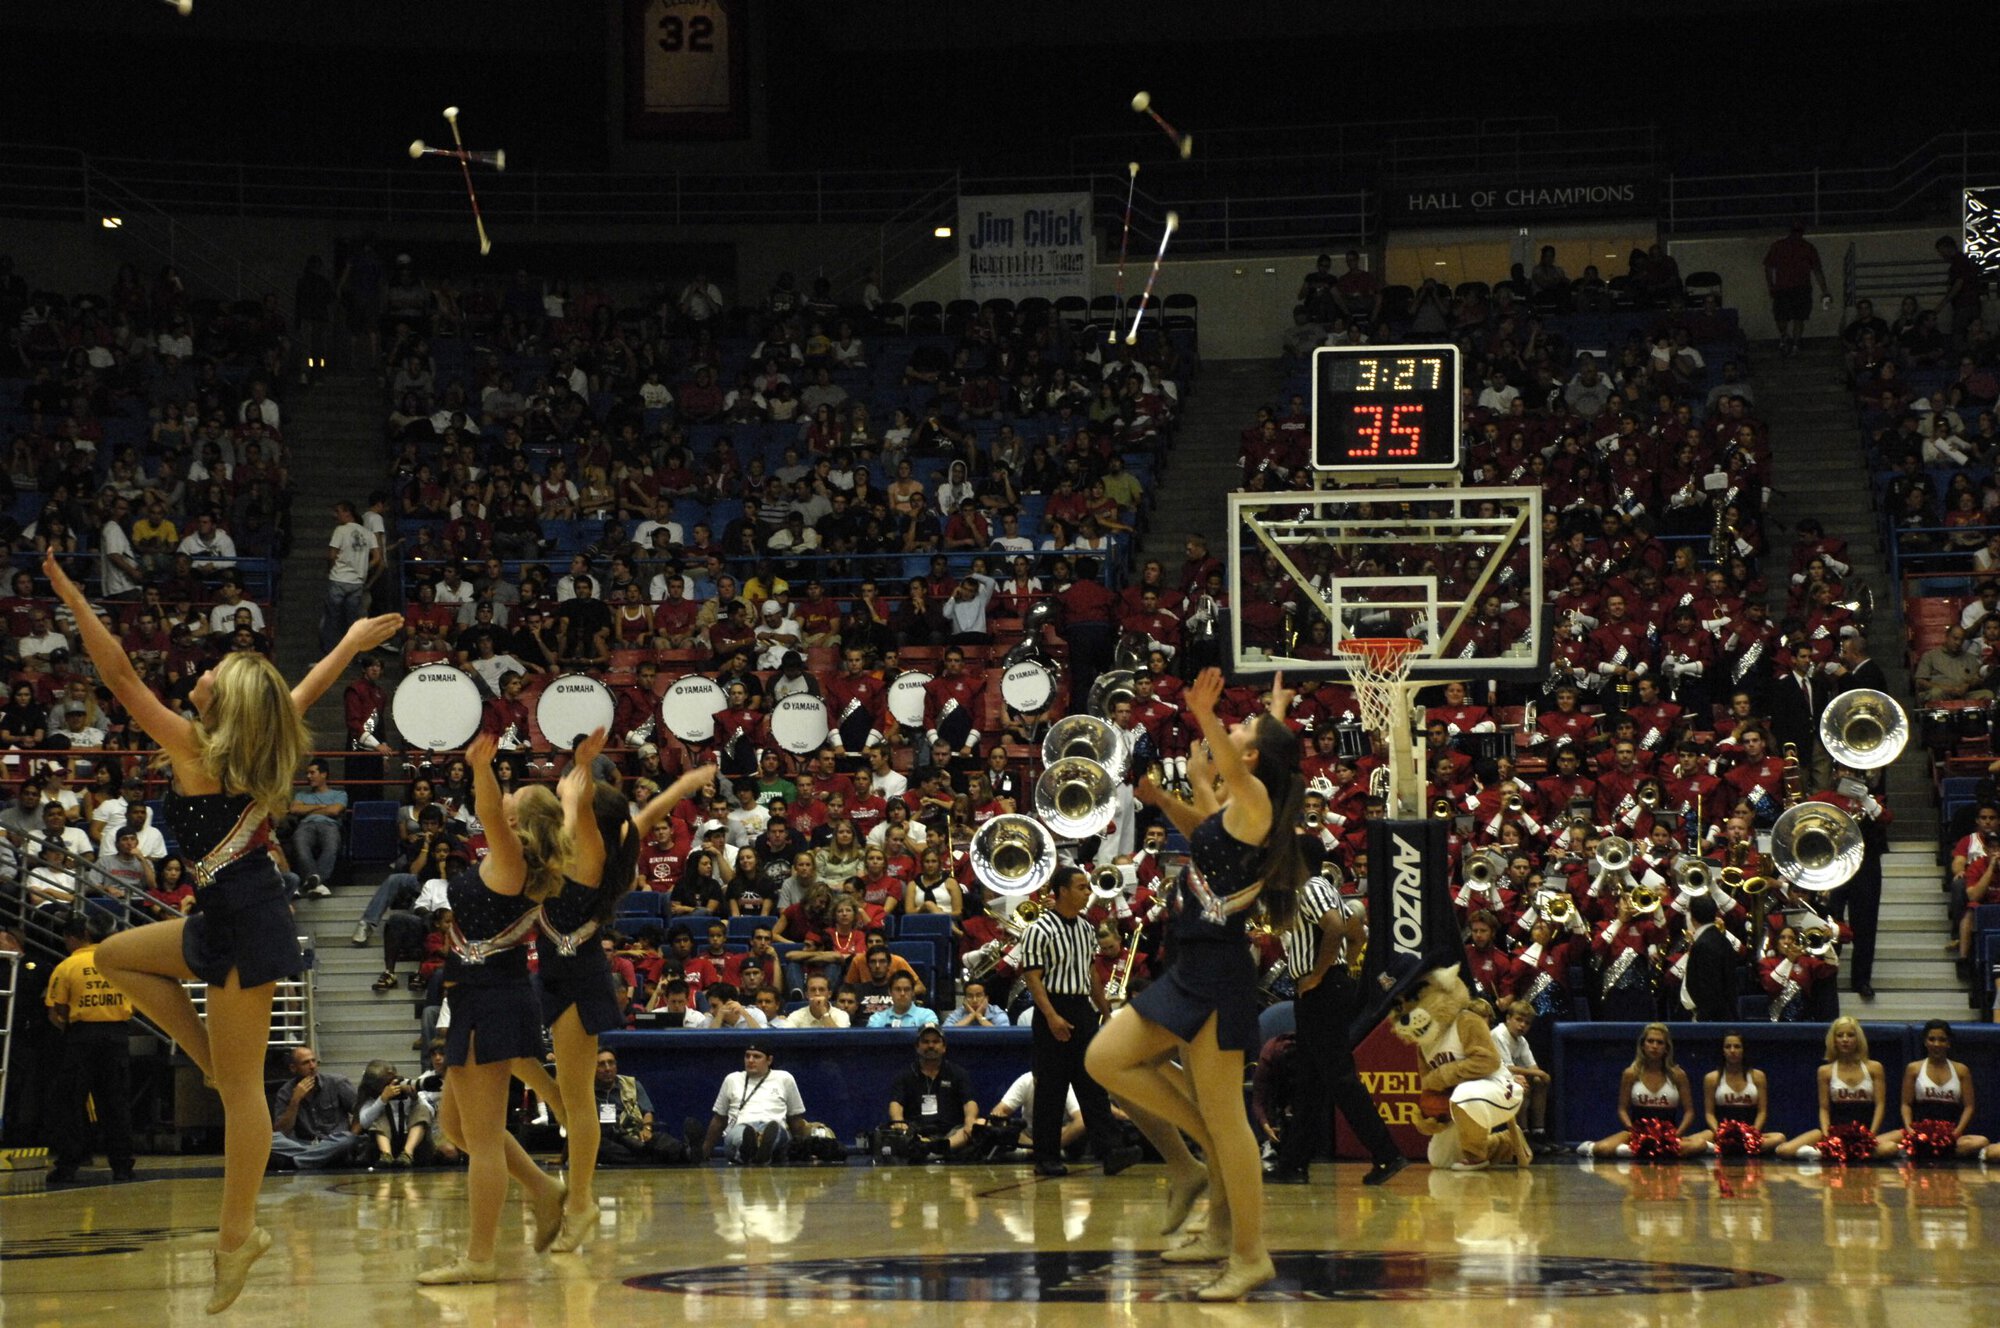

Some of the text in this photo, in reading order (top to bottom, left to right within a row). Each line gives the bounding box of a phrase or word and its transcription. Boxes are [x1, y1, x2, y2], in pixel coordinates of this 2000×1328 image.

[659, 16, 713, 52] 32
[1409, 184, 1635, 210] HALL OF CHAMPIONS
[969, 208, 1083, 249] Jim Click
[1356, 358, 1441, 391] 3:27
[1347, 406, 1424, 457] 35
[427, 674, 457, 682] YAMAHA
[1015, 669, 1040, 681] YAMAHA
[565, 685, 594, 694] YAMAHA
[684, 685, 713, 694] YAMAHA
[791, 702, 820, 711] YAMAHA
[86, 981, 110, 989] STA
[79, 993, 125, 1008] SECURIT
